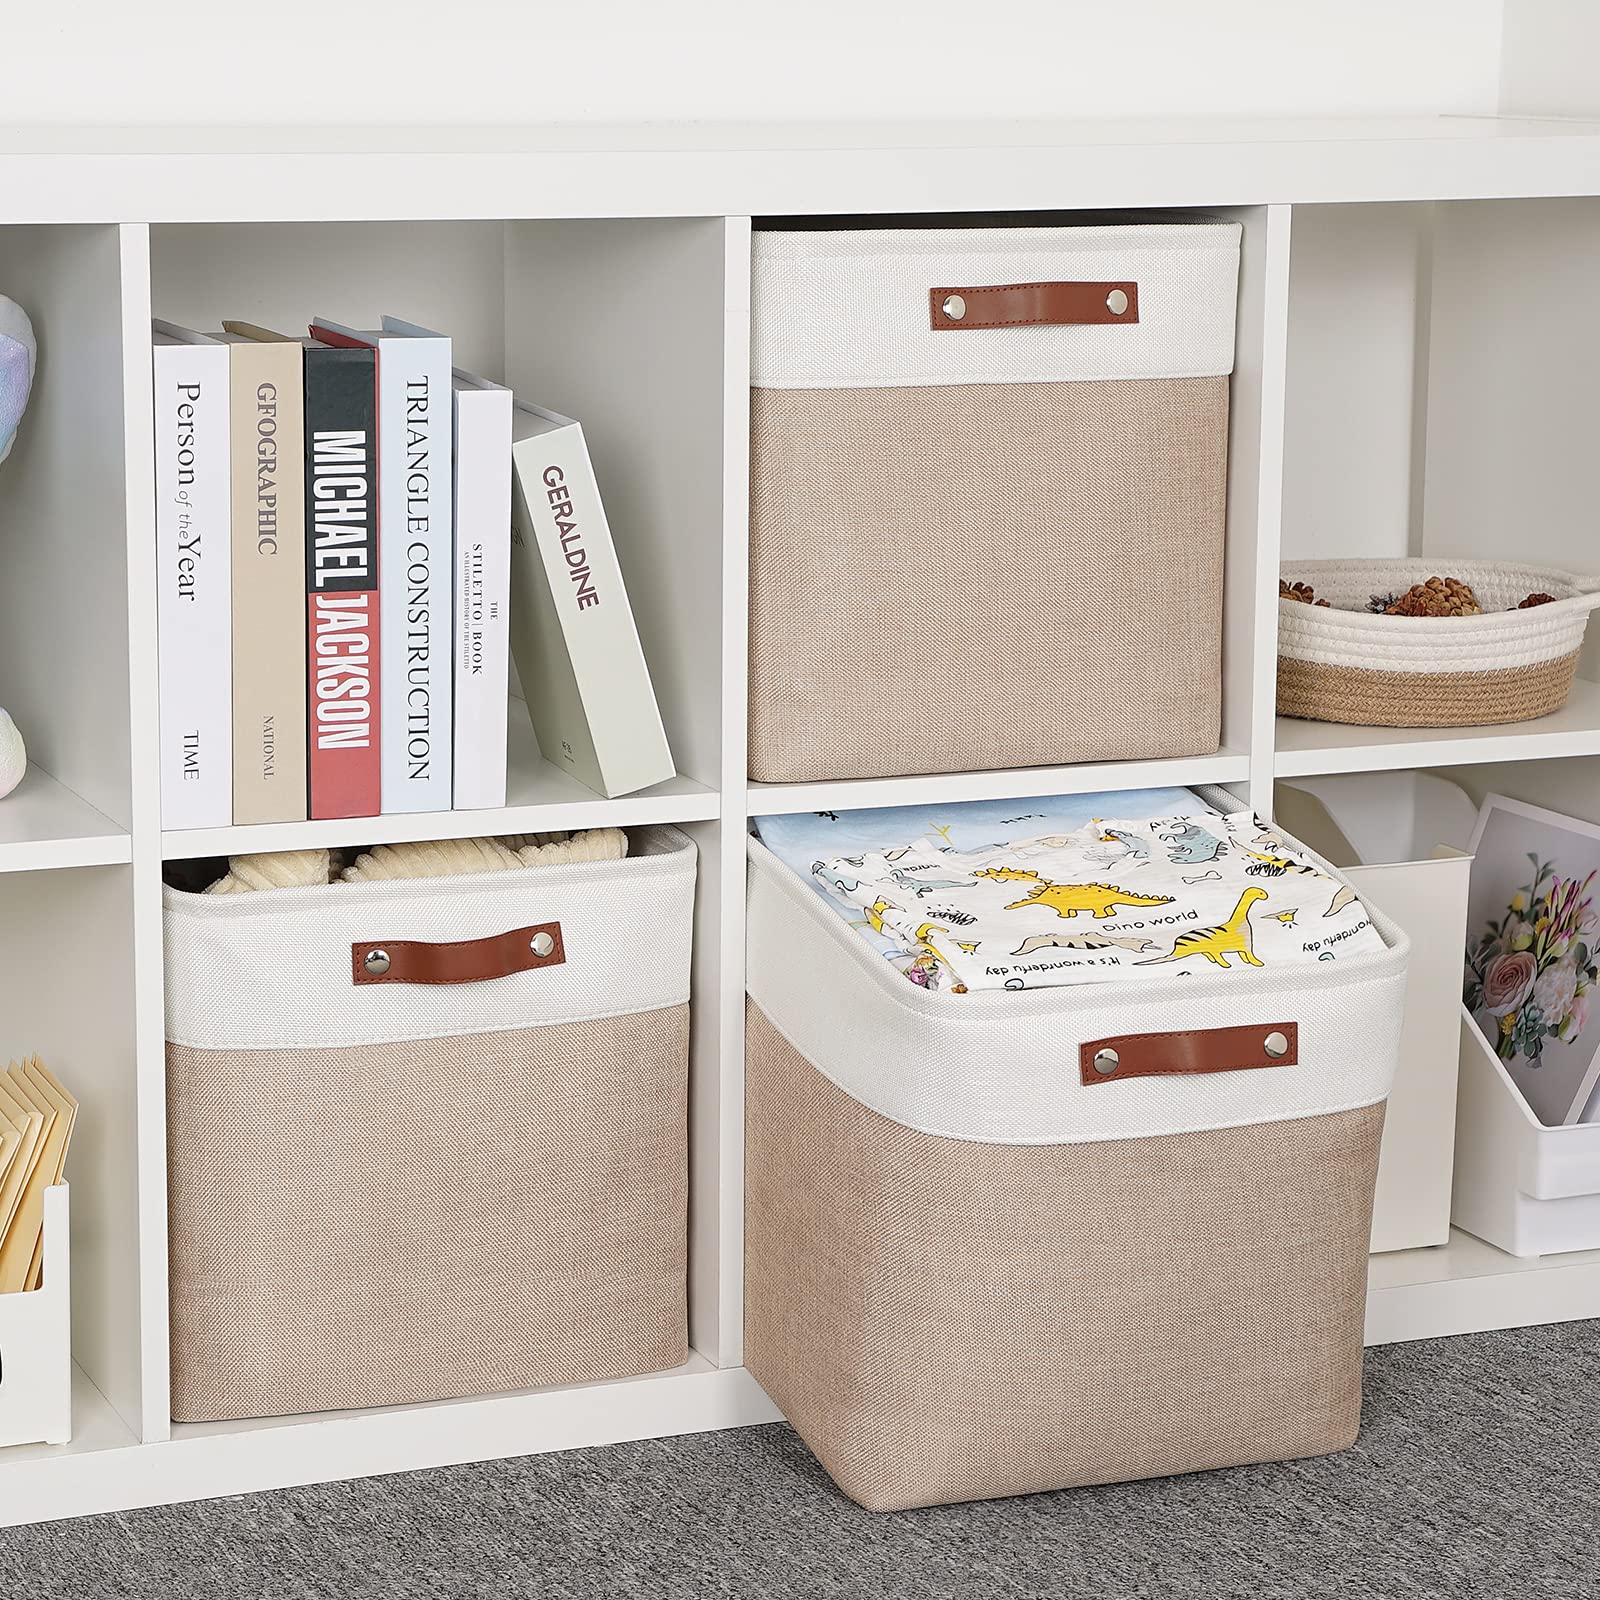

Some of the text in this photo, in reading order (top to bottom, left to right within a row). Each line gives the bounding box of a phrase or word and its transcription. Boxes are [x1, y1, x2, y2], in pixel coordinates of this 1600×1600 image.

[175, 381, 201, 601] Person of the Year
[543, 465, 600, 611] GERALDINE
[313, 430, 371, 749] MICHAEL JACKSON
[406, 375, 430, 780] TRIANGLE CONSTRUCTION
[490, 601, 498, 620] THE
[472, 632, 483, 675] BOOK
[183, 730, 200, 780] TIME
[263, 715, 275, 780] NATIONAL
[1149, 909, 1199, 927] world
[1099, 956, 1121, 966] It's
[1302, 941, 1321, 952] day
[985, 964, 1009, 976] day
